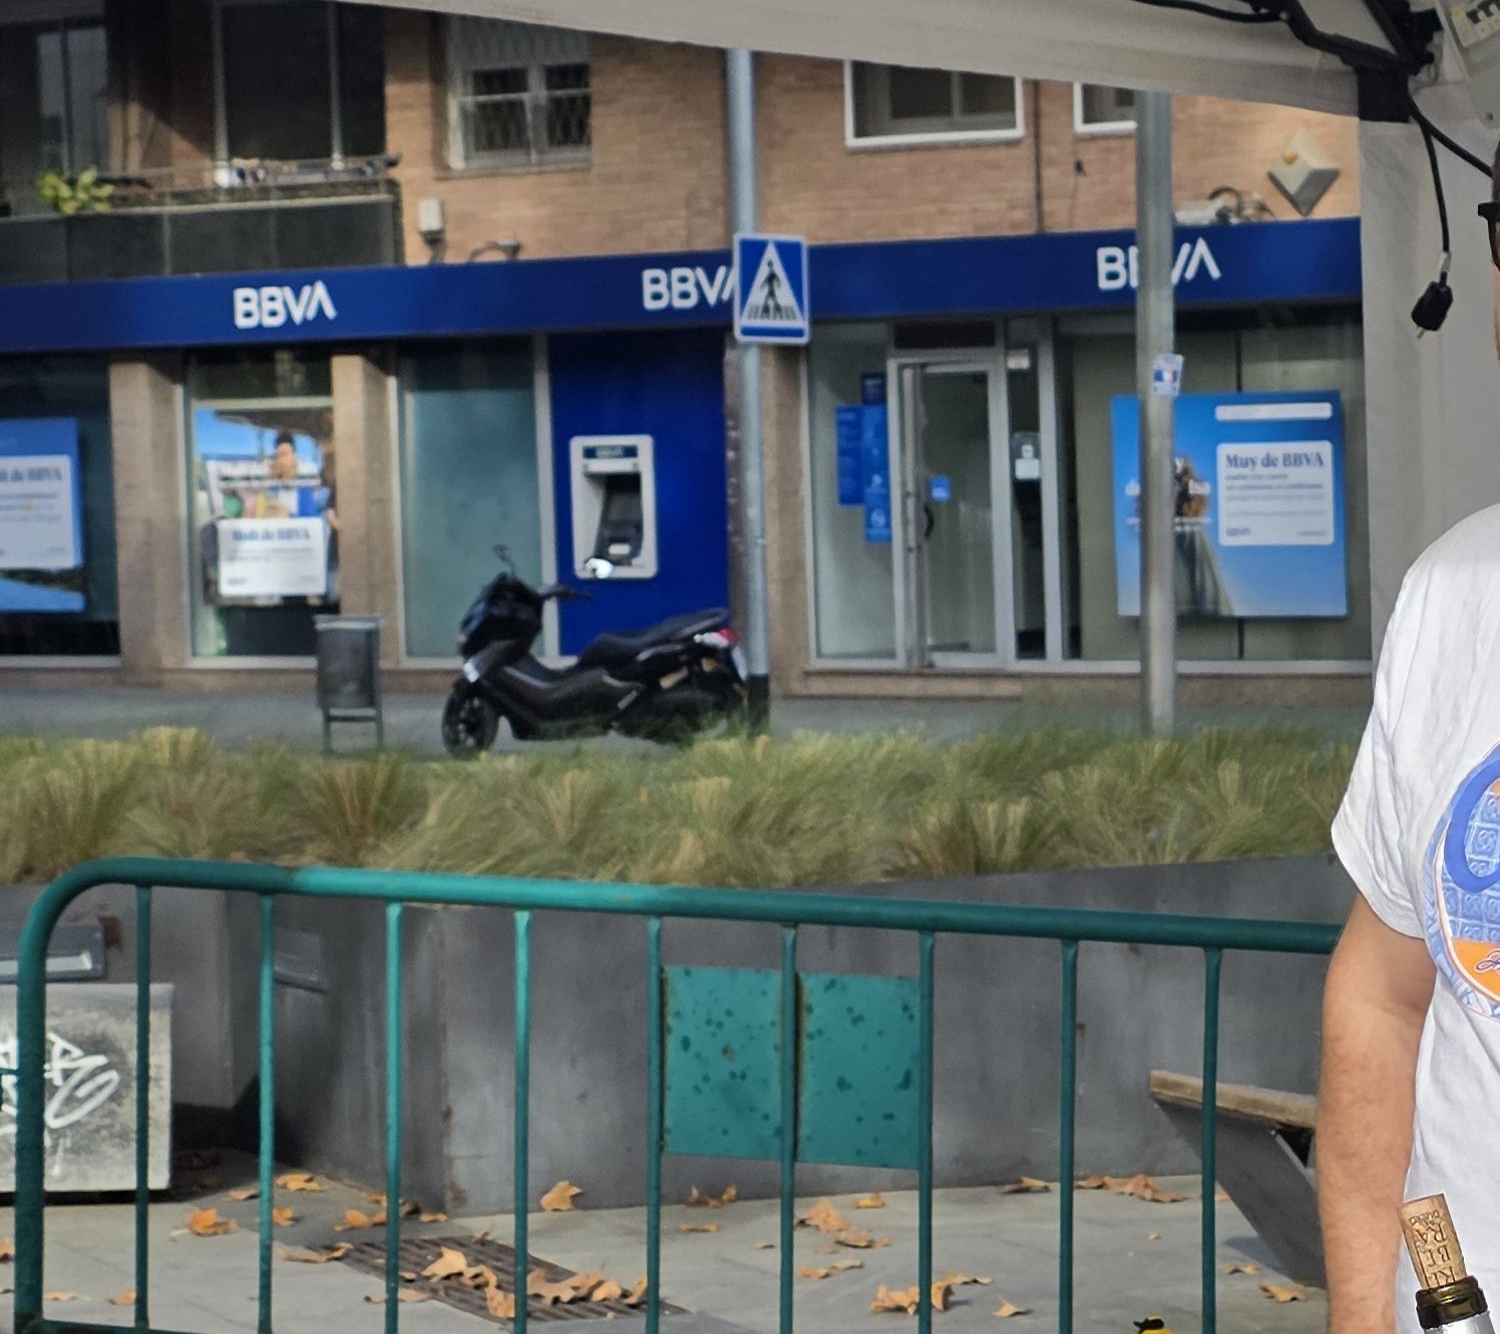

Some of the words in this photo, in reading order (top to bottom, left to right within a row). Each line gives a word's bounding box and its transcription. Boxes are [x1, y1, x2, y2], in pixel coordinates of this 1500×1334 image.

[233, 280, 337, 329] BBVA
[1225, 453, 1258, 470] Muy
[1261, 452, 1279, 467] de
[1282, 451, 1325, 468] BBVA
